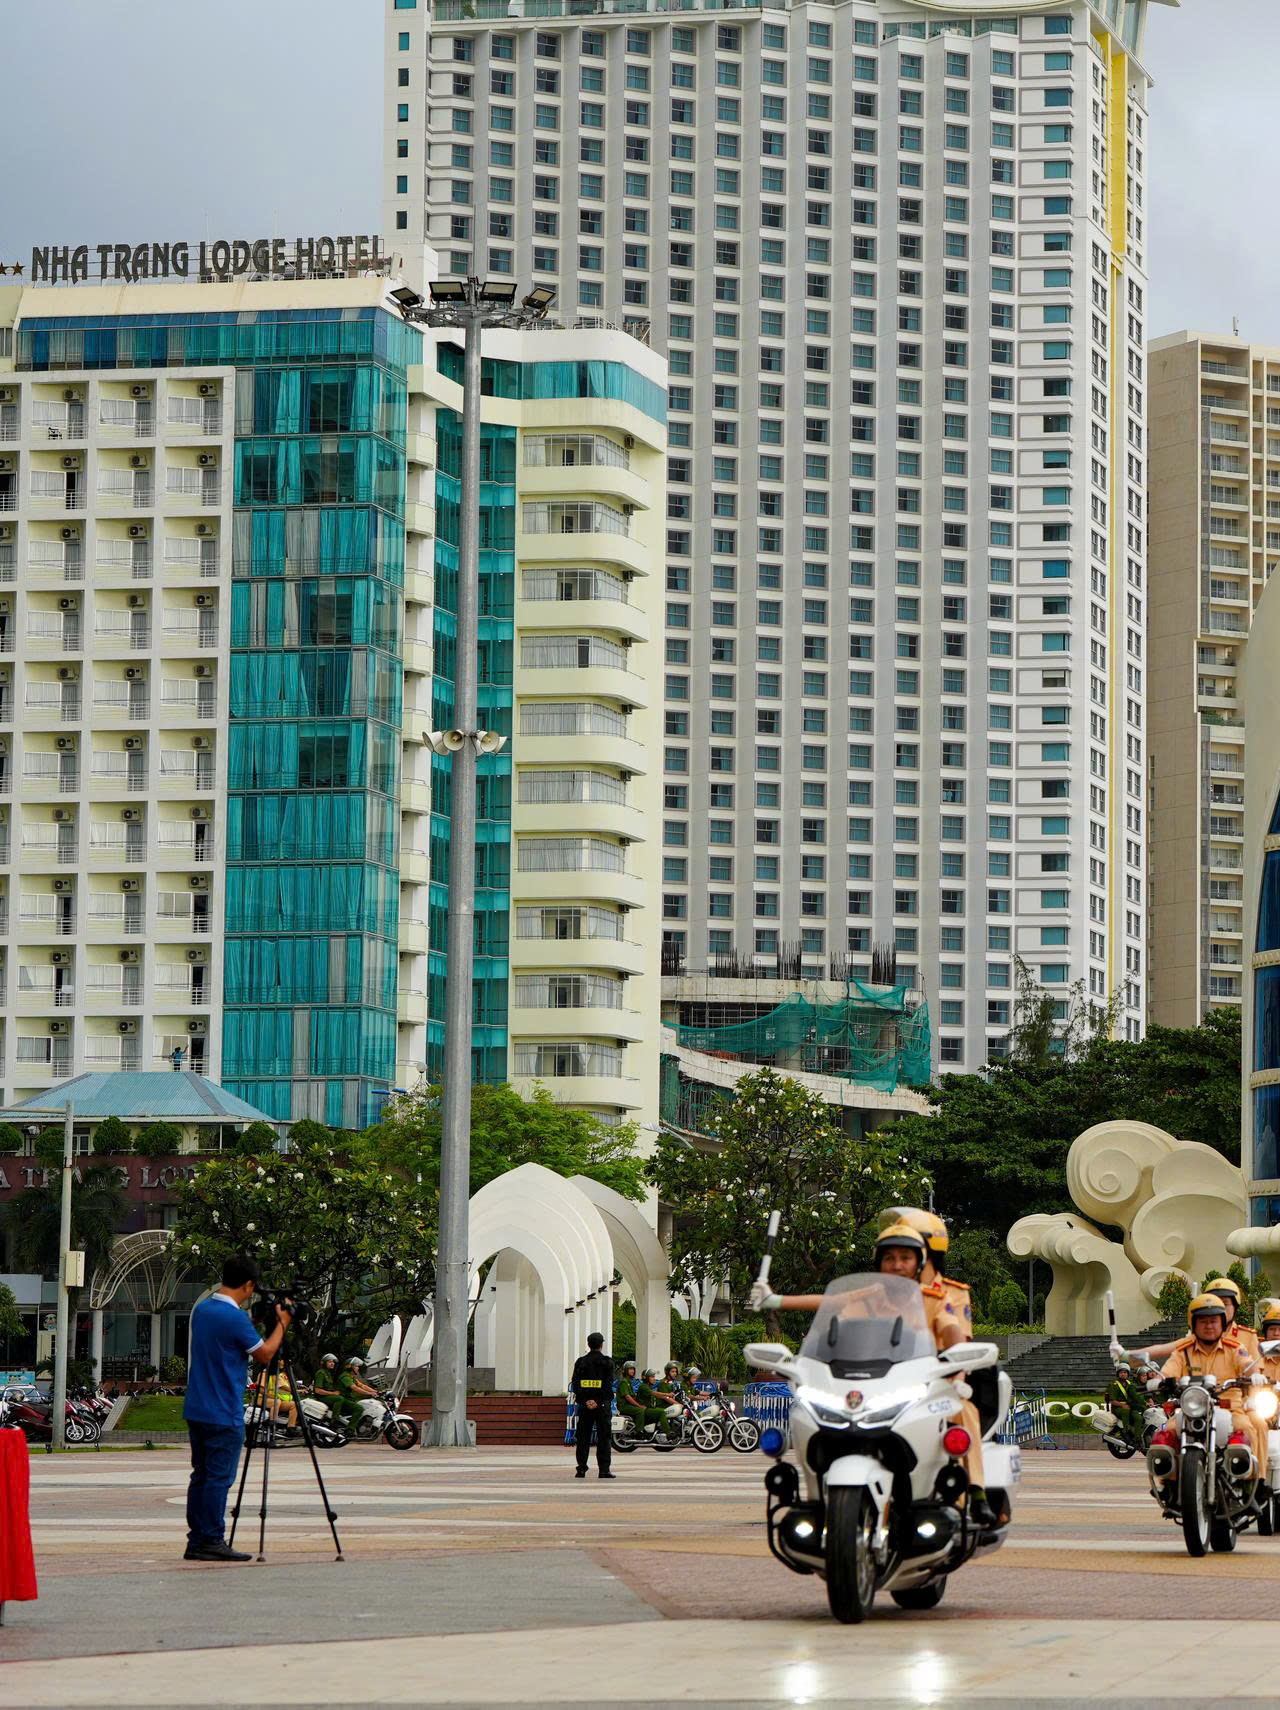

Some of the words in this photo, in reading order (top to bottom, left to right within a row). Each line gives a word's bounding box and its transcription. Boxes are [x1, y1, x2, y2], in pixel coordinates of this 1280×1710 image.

[32, 245, 88, 286] NHA
[97, 242, 188, 283] TRANG
[199, 239, 286, 282] LODGE
[297, 235, 378, 274] HOTEL
